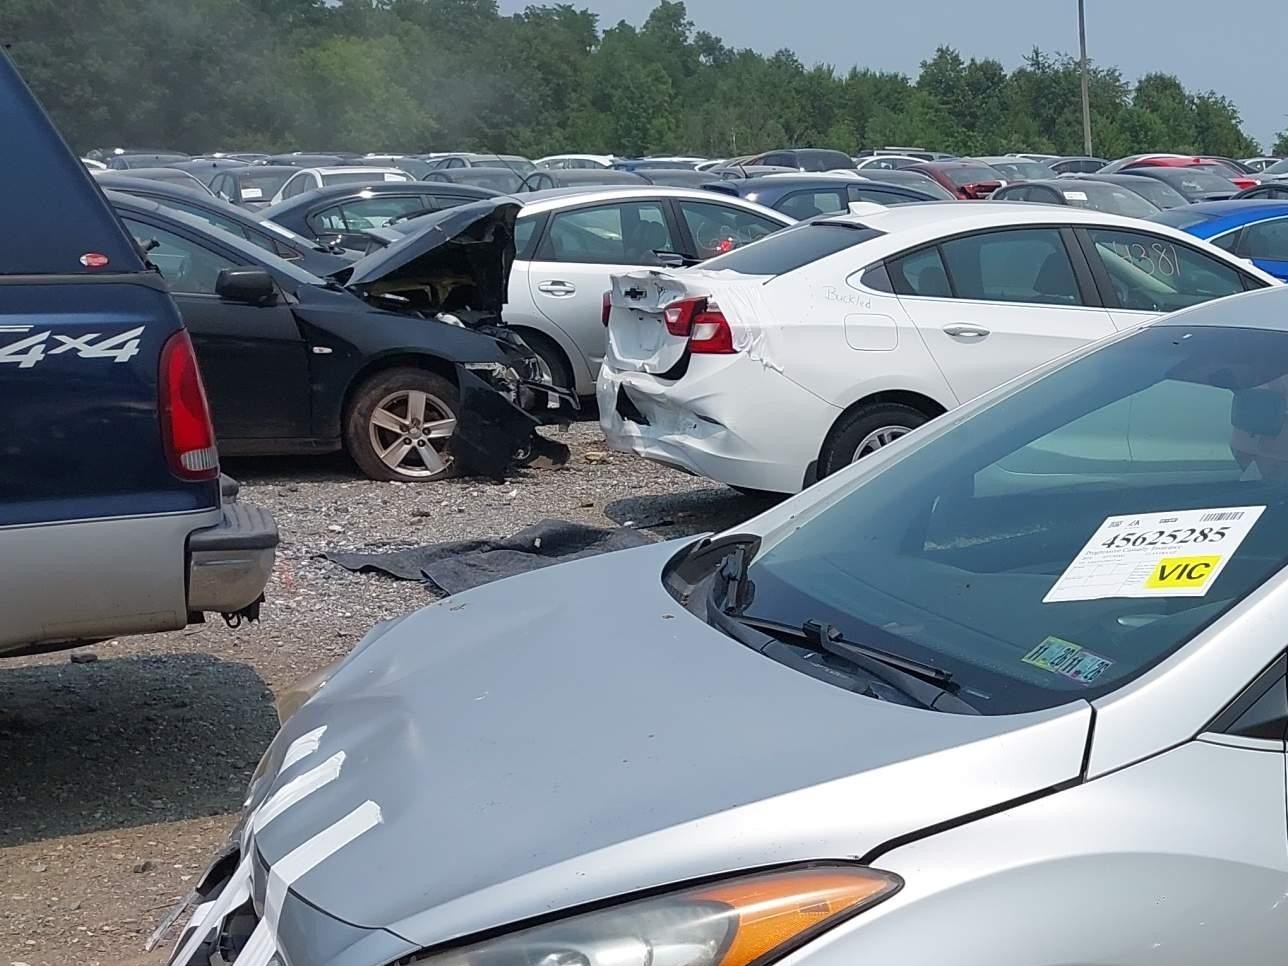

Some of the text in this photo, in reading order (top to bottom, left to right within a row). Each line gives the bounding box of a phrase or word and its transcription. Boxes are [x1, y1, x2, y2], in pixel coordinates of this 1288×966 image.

[823, 285, 871, 309] Buckled
[0, 325, 145, 368] 4x4
[1102, 526, 1232, 549] 45625285
[1158, 562, 1211, 581] VIC
